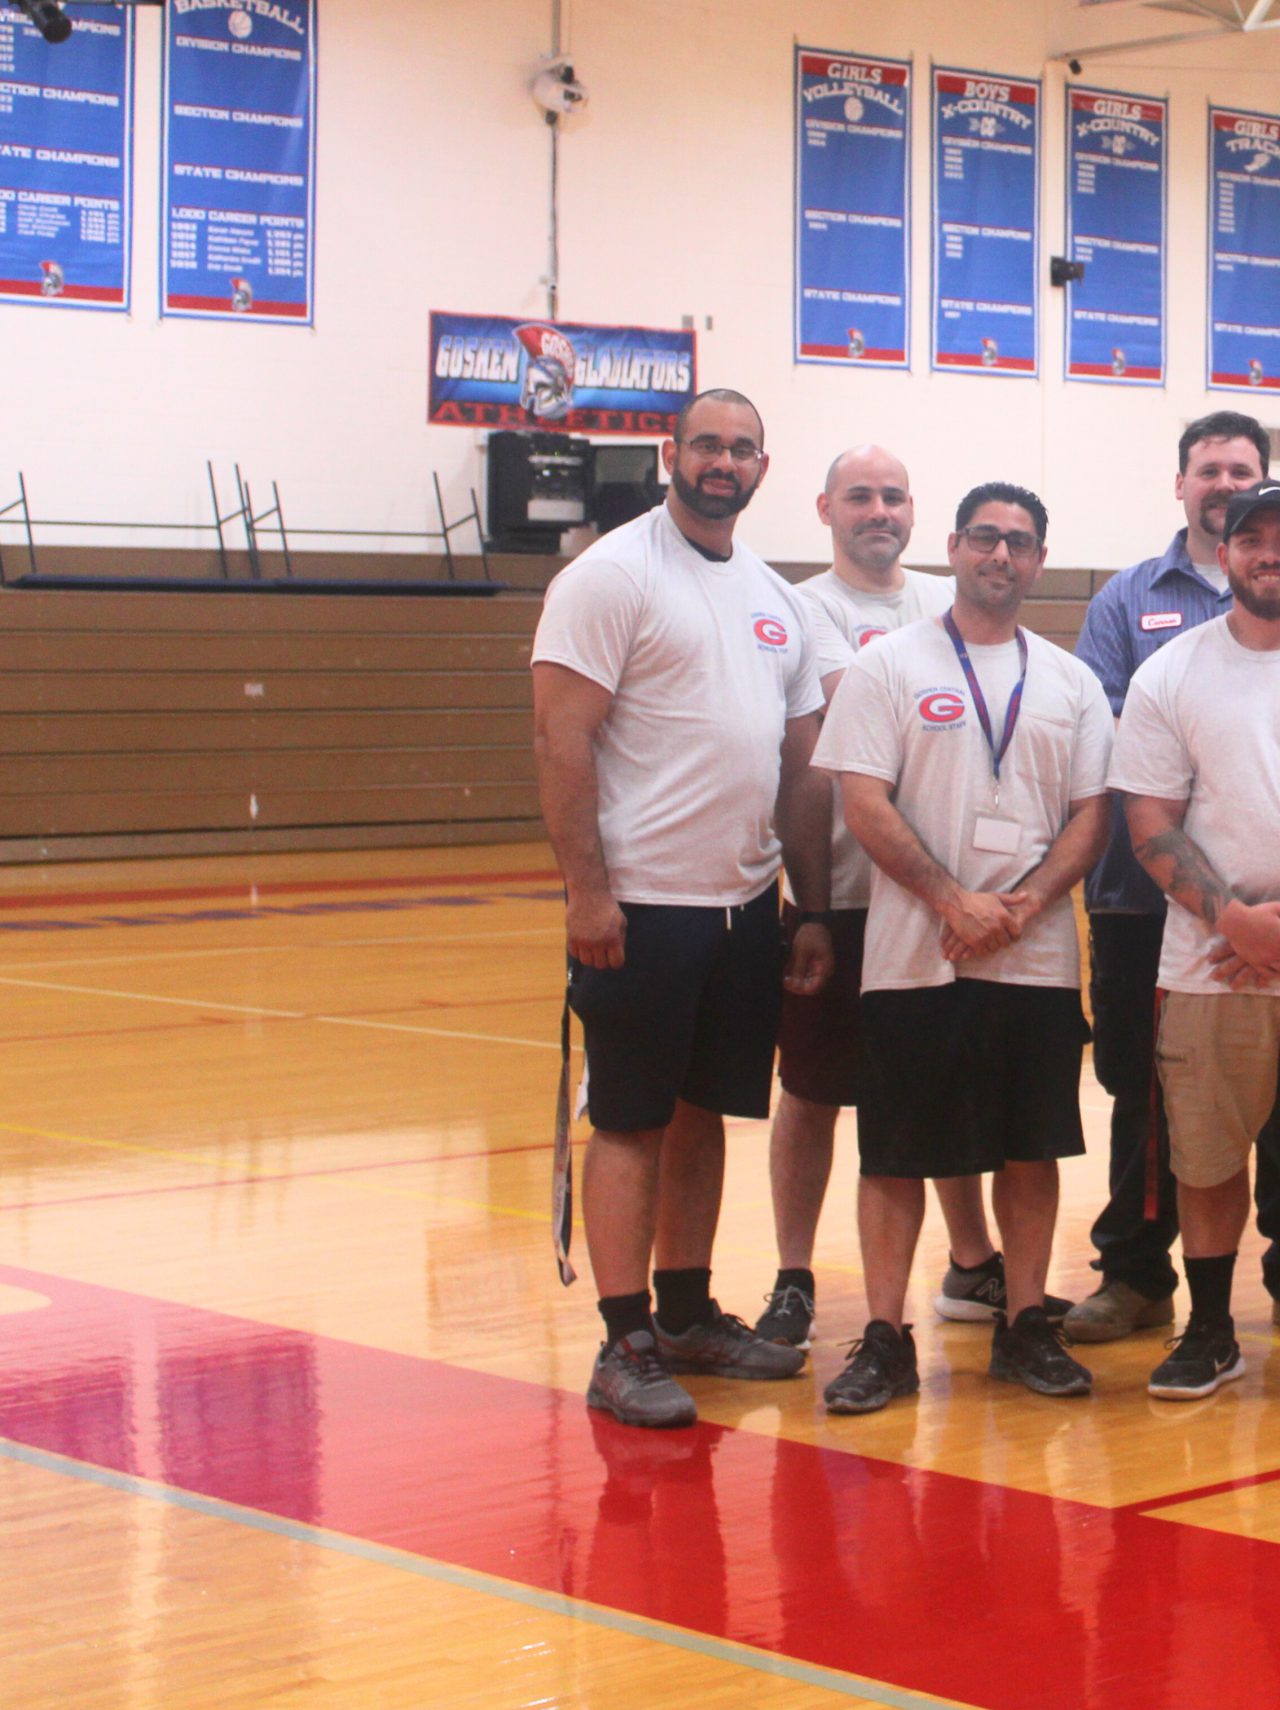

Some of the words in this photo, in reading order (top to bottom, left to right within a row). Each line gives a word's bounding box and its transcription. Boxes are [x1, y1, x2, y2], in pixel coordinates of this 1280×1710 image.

[71, 20, 120, 36] MPIONS
[176, 35, 229, 52] DIVISION
[231, 42, 301, 60] CHAMPIONS
[827, 62, 883, 85] GIRLS
[0, 82, 40, 97] CTION
[42, 87, 119, 107] CHAMPIONS
[803, 81, 904, 115] VOLLEYBALL
[964, 81, 1012, 102] BOYS
[174, 104, 229, 121] SECTION
[232, 111, 302, 128] CHAMPIONS
[941, 99, 1032, 130] X-COUNTRY
[1093, 100, 1142, 121] GIRLS
[849, 124, 903, 139] CHAMPIONS
[1076, 118, 1160, 147] X-COUNTRY
[1234, 120, 1280, 141] GIRLS
[1, 145, 31, 158] ATE
[35, 148, 119, 168] CHAMPIONS
[981, 140, 1032, 155] CHAMPIONS
[174, 165, 222, 179] STATE
[226, 170, 302, 187] CHAMPIONS
[17, 191, 71, 207] CAREER
[74, 196, 119, 211] POINTS
[207, 210, 257, 224] CAREER
[260, 215, 304, 229] POINTS
[848, 214, 902, 228] CHAMPIONS
[981, 228, 1032, 241] CHAMPIONS
[804, 288, 840, 302] STATE
[842, 292, 902, 306] CHAMPIONS
[941, 299, 974, 312] STATE
[976, 302, 1032, 316] CHAMPIONS
[1074, 310, 1106, 322] STATE
[1107, 313, 1159, 326] CHAMPIONS
[435, 335, 520, 382] GOSHEN
[573, 348, 692, 393] GLADIATORS
[753, 618, 787, 646] G
[918, 692, 965, 723] G
